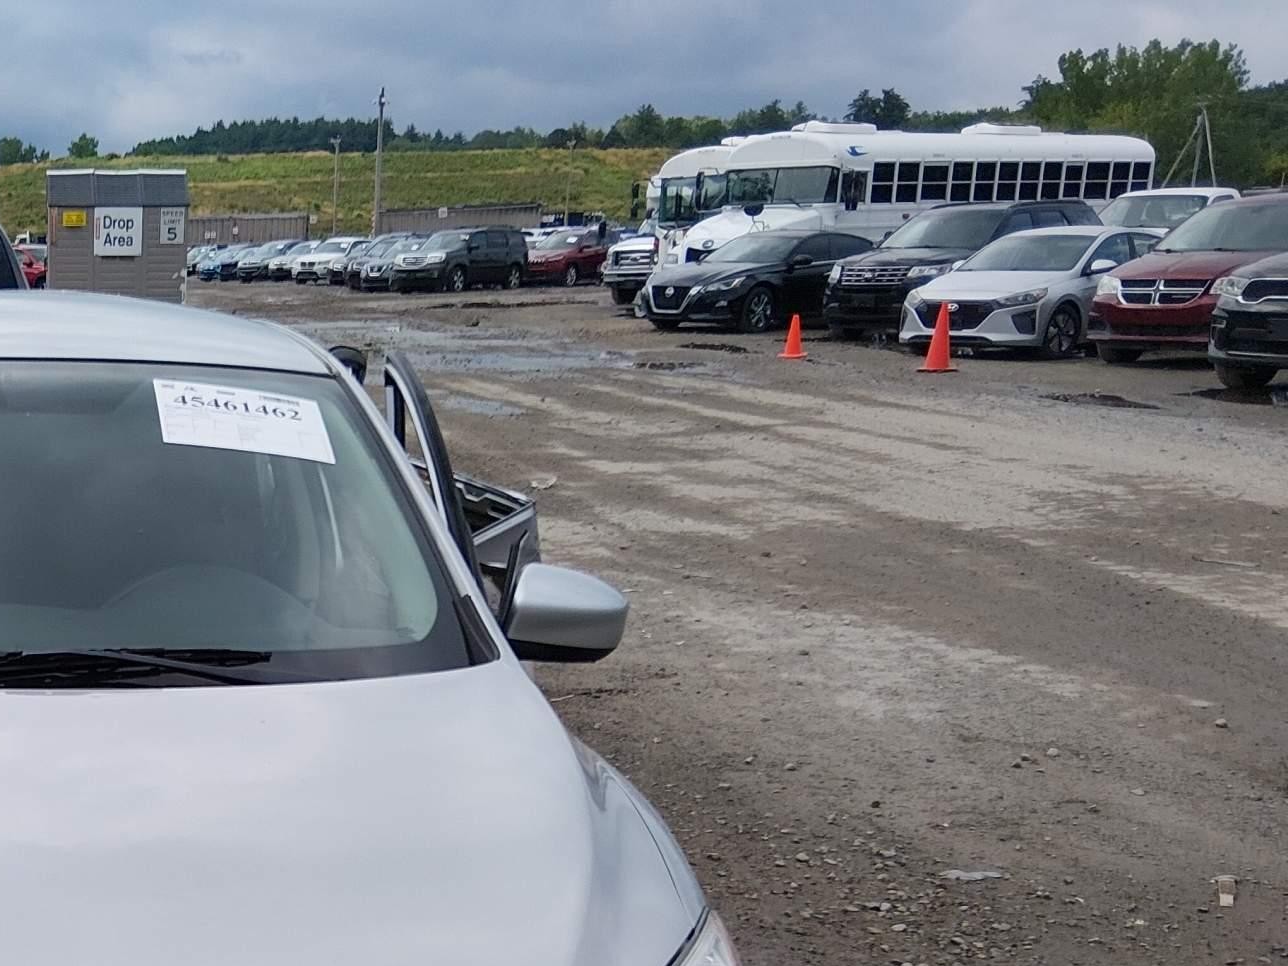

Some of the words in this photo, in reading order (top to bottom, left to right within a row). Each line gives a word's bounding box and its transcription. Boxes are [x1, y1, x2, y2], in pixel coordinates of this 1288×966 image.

[103, 215, 134, 232] Drop
[103, 233, 134, 247] Area
[167, 227, 178, 241] 5
[173, 394, 302, 422] 45461462
